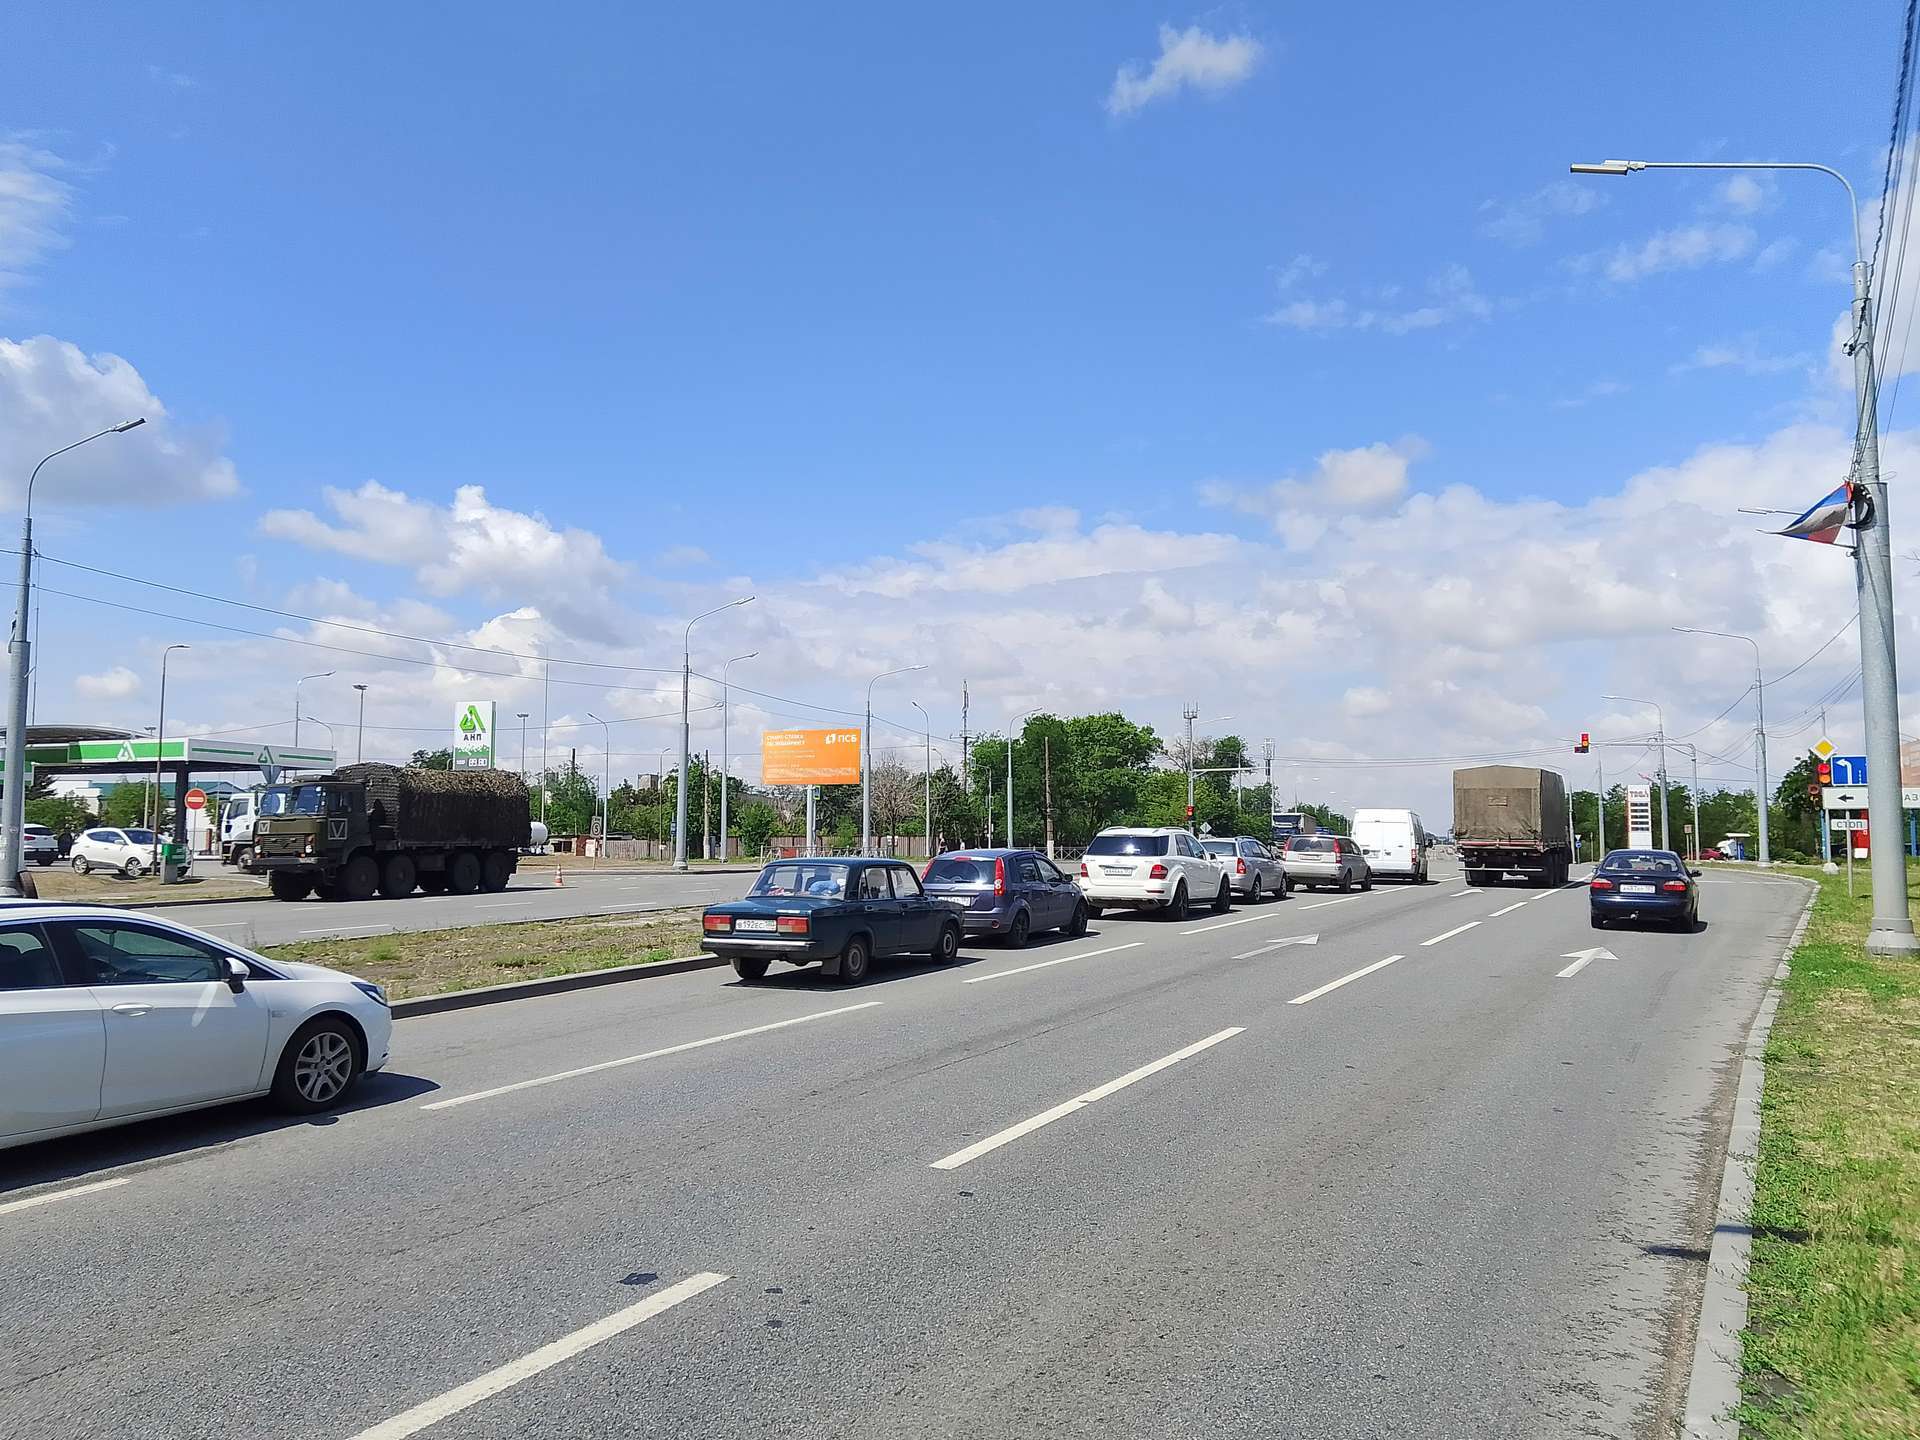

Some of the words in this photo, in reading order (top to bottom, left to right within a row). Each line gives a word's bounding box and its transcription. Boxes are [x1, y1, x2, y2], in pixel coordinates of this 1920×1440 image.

[464, 733, 481, 741] АНП
[838, 734, 857, 743] ПСБ
[1904, 793, 1919, 801] АЗ
[1836, 821, 1863, 829] СТОП
[331, 821, 345, 838] V
